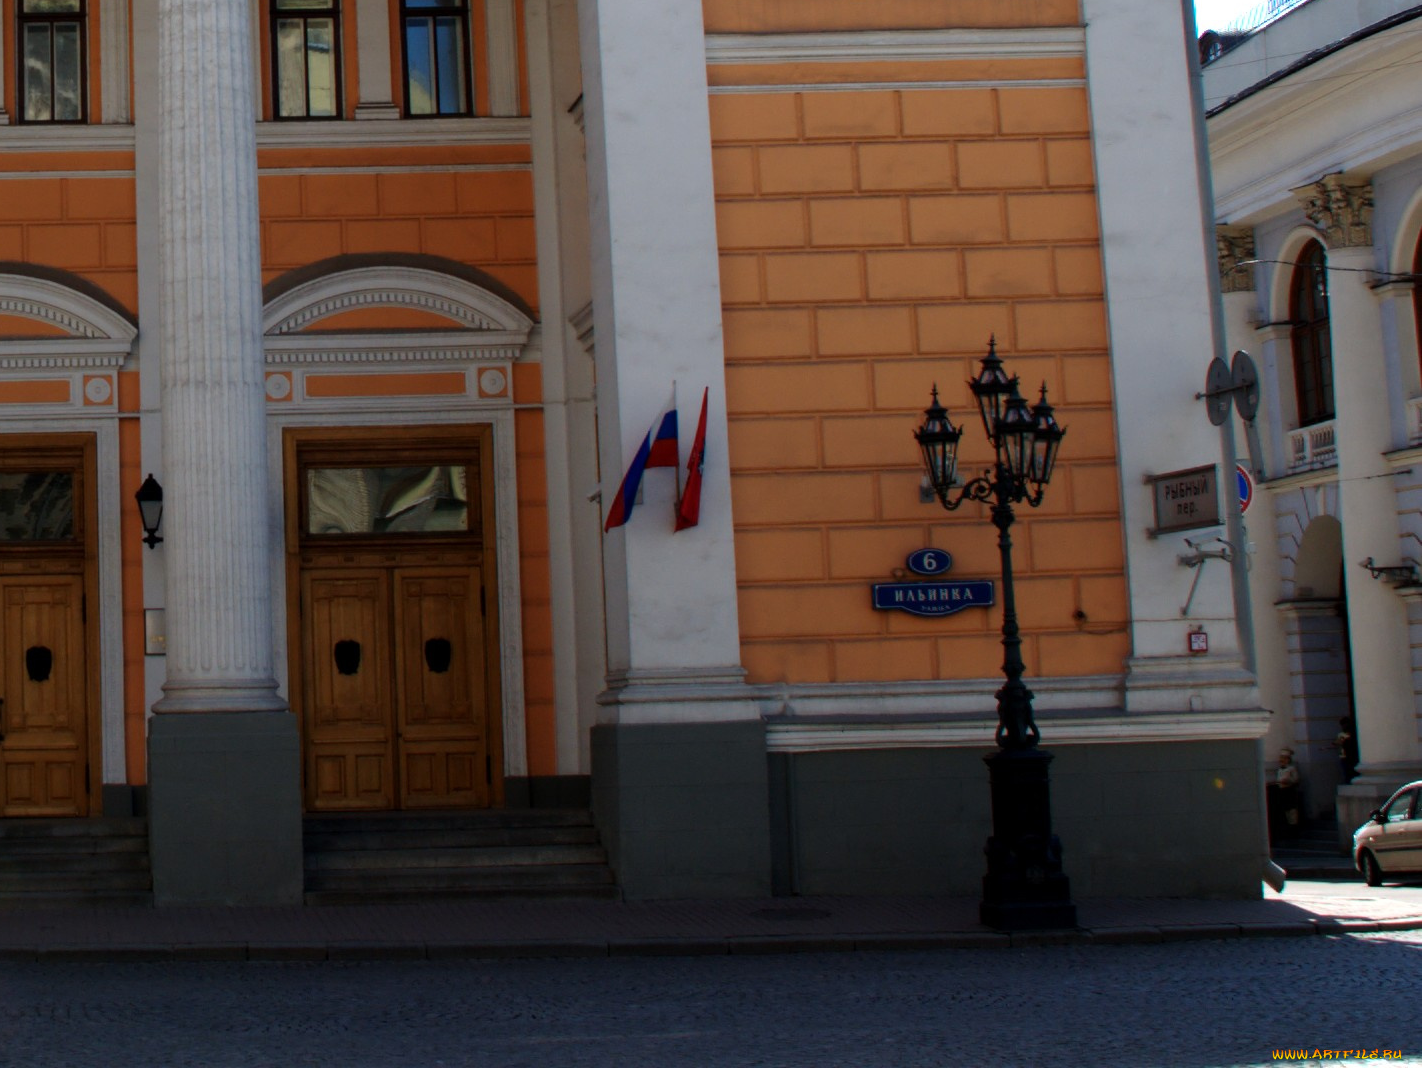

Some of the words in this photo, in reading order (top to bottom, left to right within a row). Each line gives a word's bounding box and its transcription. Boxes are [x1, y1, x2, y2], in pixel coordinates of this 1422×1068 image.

[1164, 474, 1209, 500] РЫБНЫЙ
[923, 552, 937, 570] 6
[894, 587, 974, 602] ИЛЬИНКА
